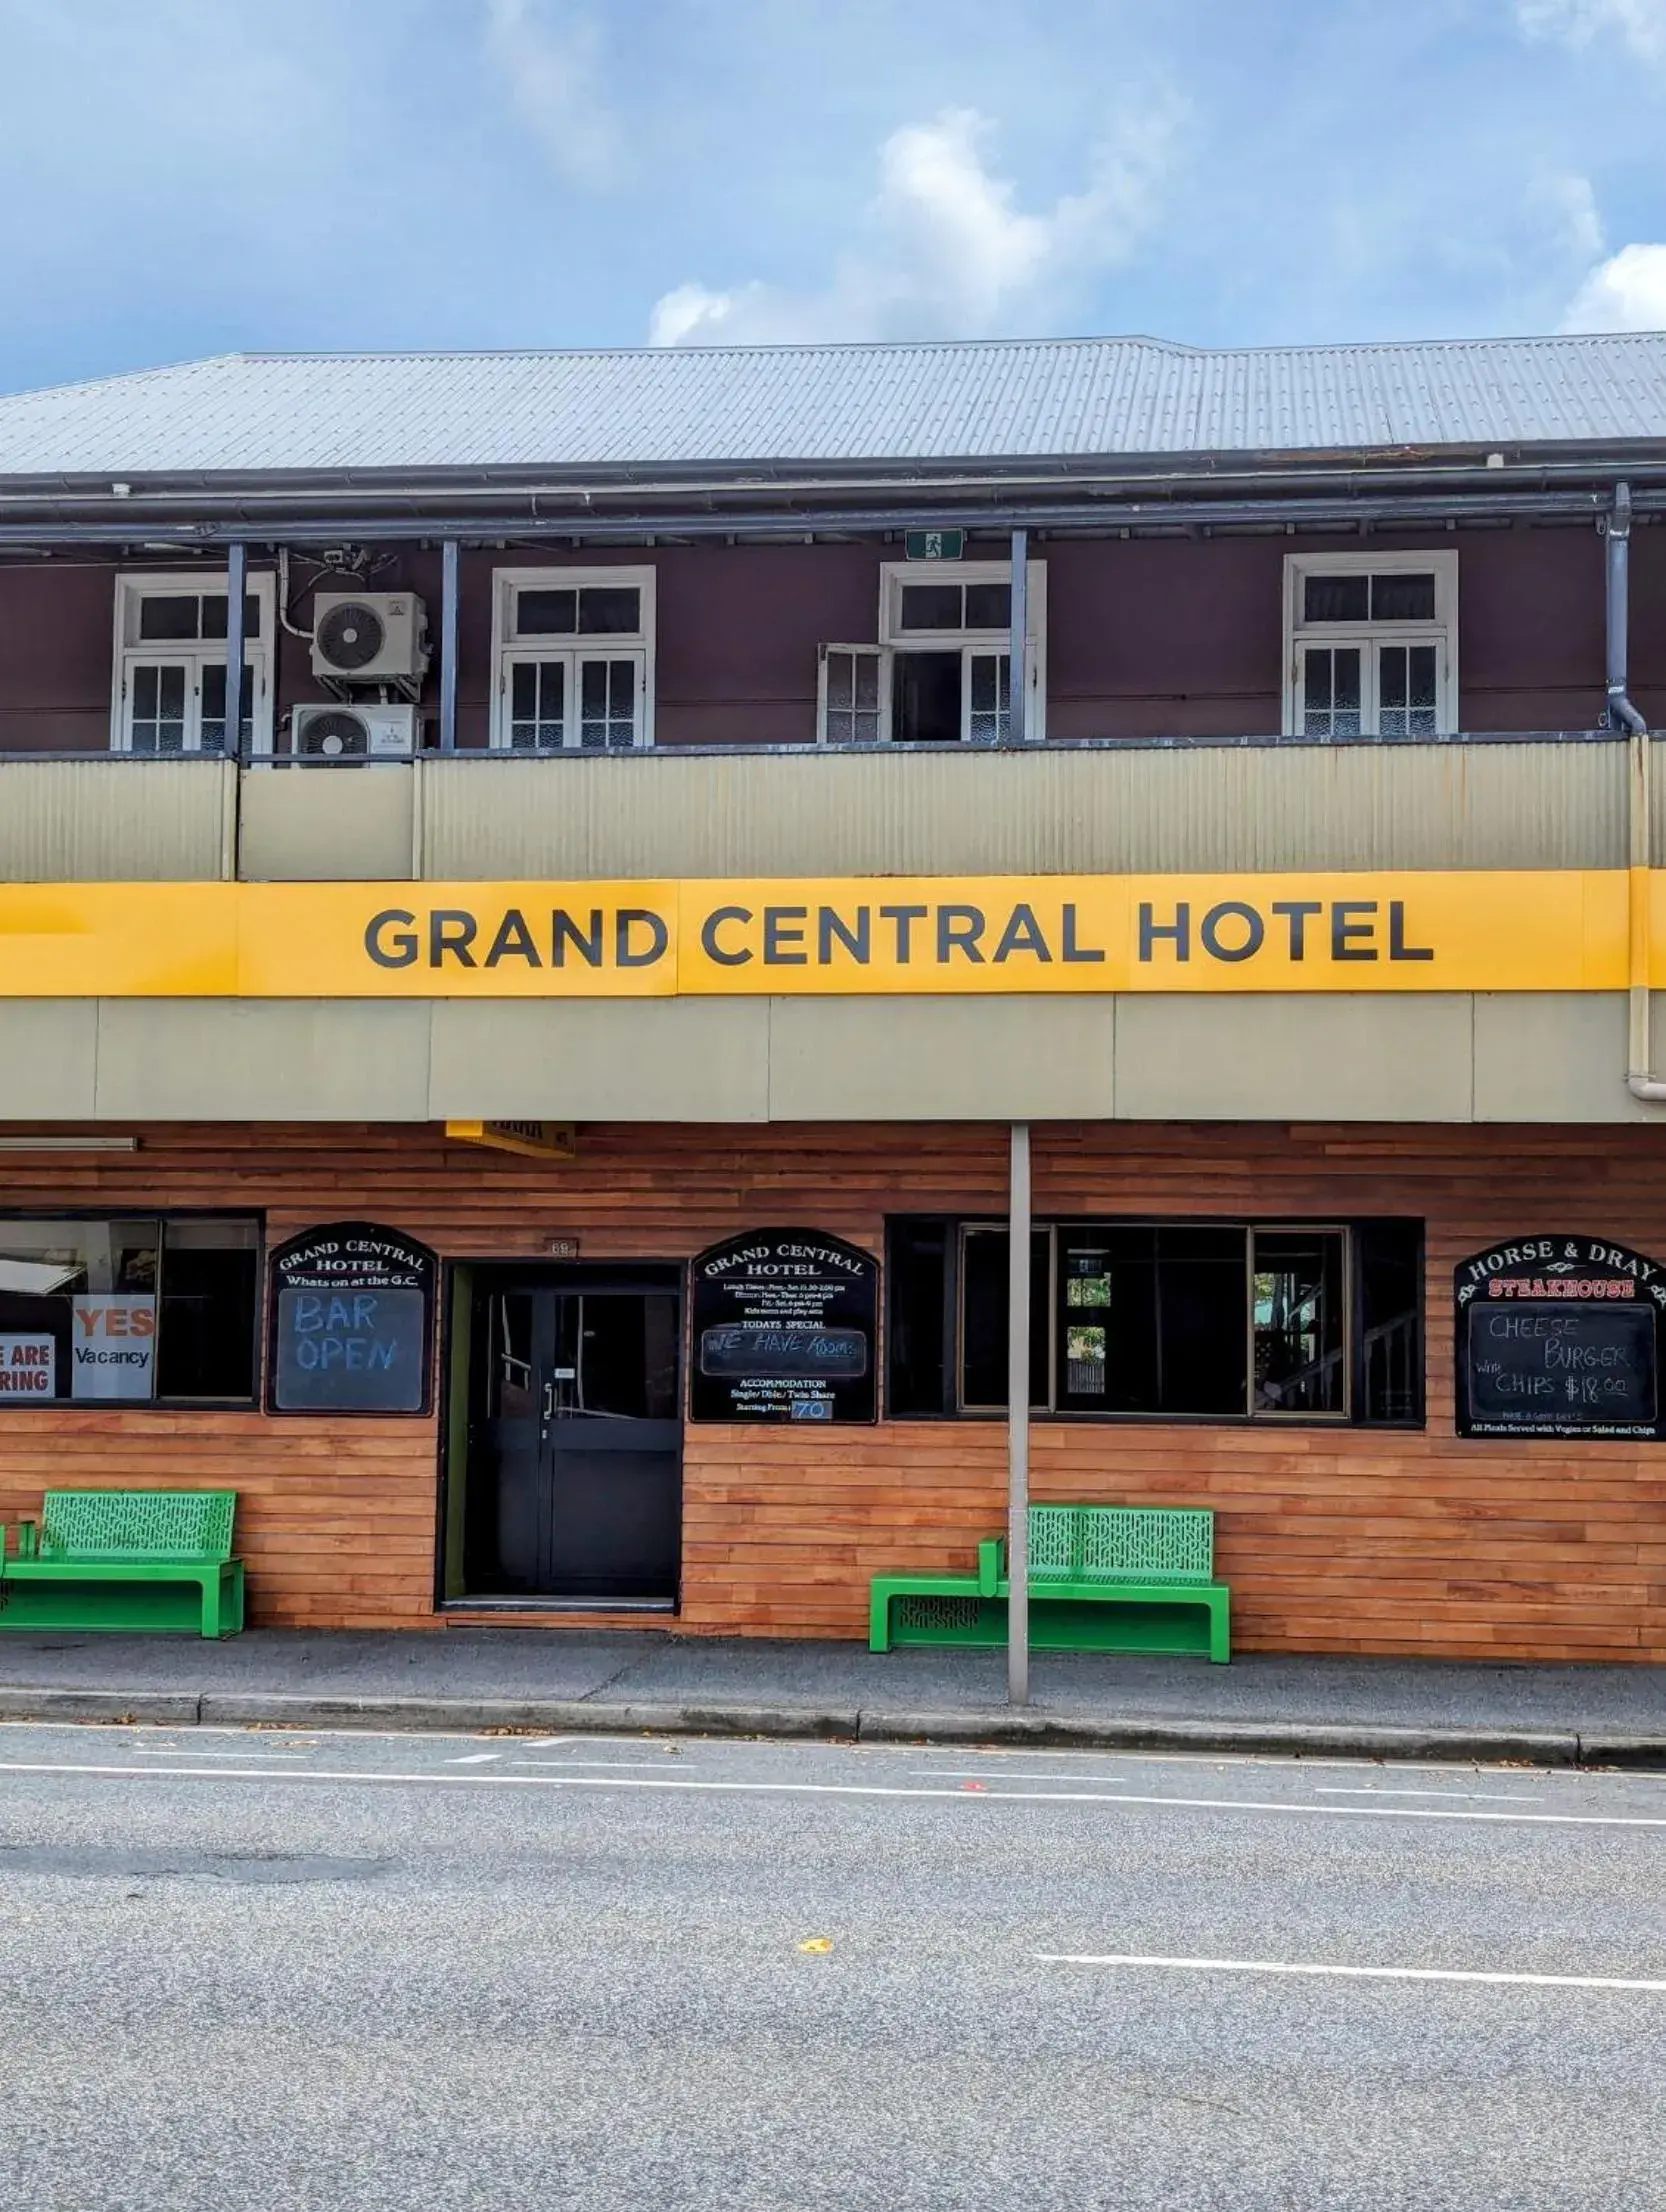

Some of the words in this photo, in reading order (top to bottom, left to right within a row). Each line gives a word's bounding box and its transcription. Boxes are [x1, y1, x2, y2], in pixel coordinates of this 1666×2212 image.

[364, 908, 669, 969] GRAND
[701, 903, 1106, 966] CENTRAL
[1138, 900, 1434, 962] HOTEL
[279, 1242, 339, 1271] GRAND
[346, 1240, 425, 1271] CENTRAL
[316, 1260, 390, 1271] HOTEL
[704, 1246, 769, 1276] GRAND
[776, 1244, 865, 1276] CENTRAL
[1468, 1241, 1554, 1282] HORSE
[1564, 1242, 1579, 1258] &
[1589, 1243, 1658, 1281] DRAY
[747, 1264, 823, 1275] HOTEL
[286, 1275, 330, 1287] Whats
[331, 1278, 349, 1287] on
[350, 1277, 365, 1286] at
[367, 1275, 389, 1286] the
[1488, 1279, 1635, 1297] STEAKHOUSE
[76, 1308, 155, 1337] YES
[294, 1294, 378, 1333] BAR
[741, 1320, 782, 1329] TODAYS
[1489, 1315, 1580, 1339] CHEESE
[707, 1332, 742, 1351] WE
[753, 1332, 803, 1352] HAVE
[12, 1345, 49, 1366] ARE
[75, 1347, 149, 1368] Vacancy
[296, 1337, 397, 1370] OPEN
[1544, 1338, 1627, 1370] BURGER
[740, 1379, 827, 1388] ACCOMMODATION
[1495, 1372, 1555, 1396] CHIPS
[788, 1390, 809, 1399] Twin
[810, 1390, 836, 1399] Share
[736, 1403, 766, 1413] Starting
[796, 1402, 825, 1417] 70
[1471, 1424, 1483, 1432] All
[1507, 1424, 1535, 1432] Served
[1592, 1425, 1614, 1434] Salad
[1615, 1426, 1631, 1434] and
[1632, 1426, 1656, 1435] Chips
